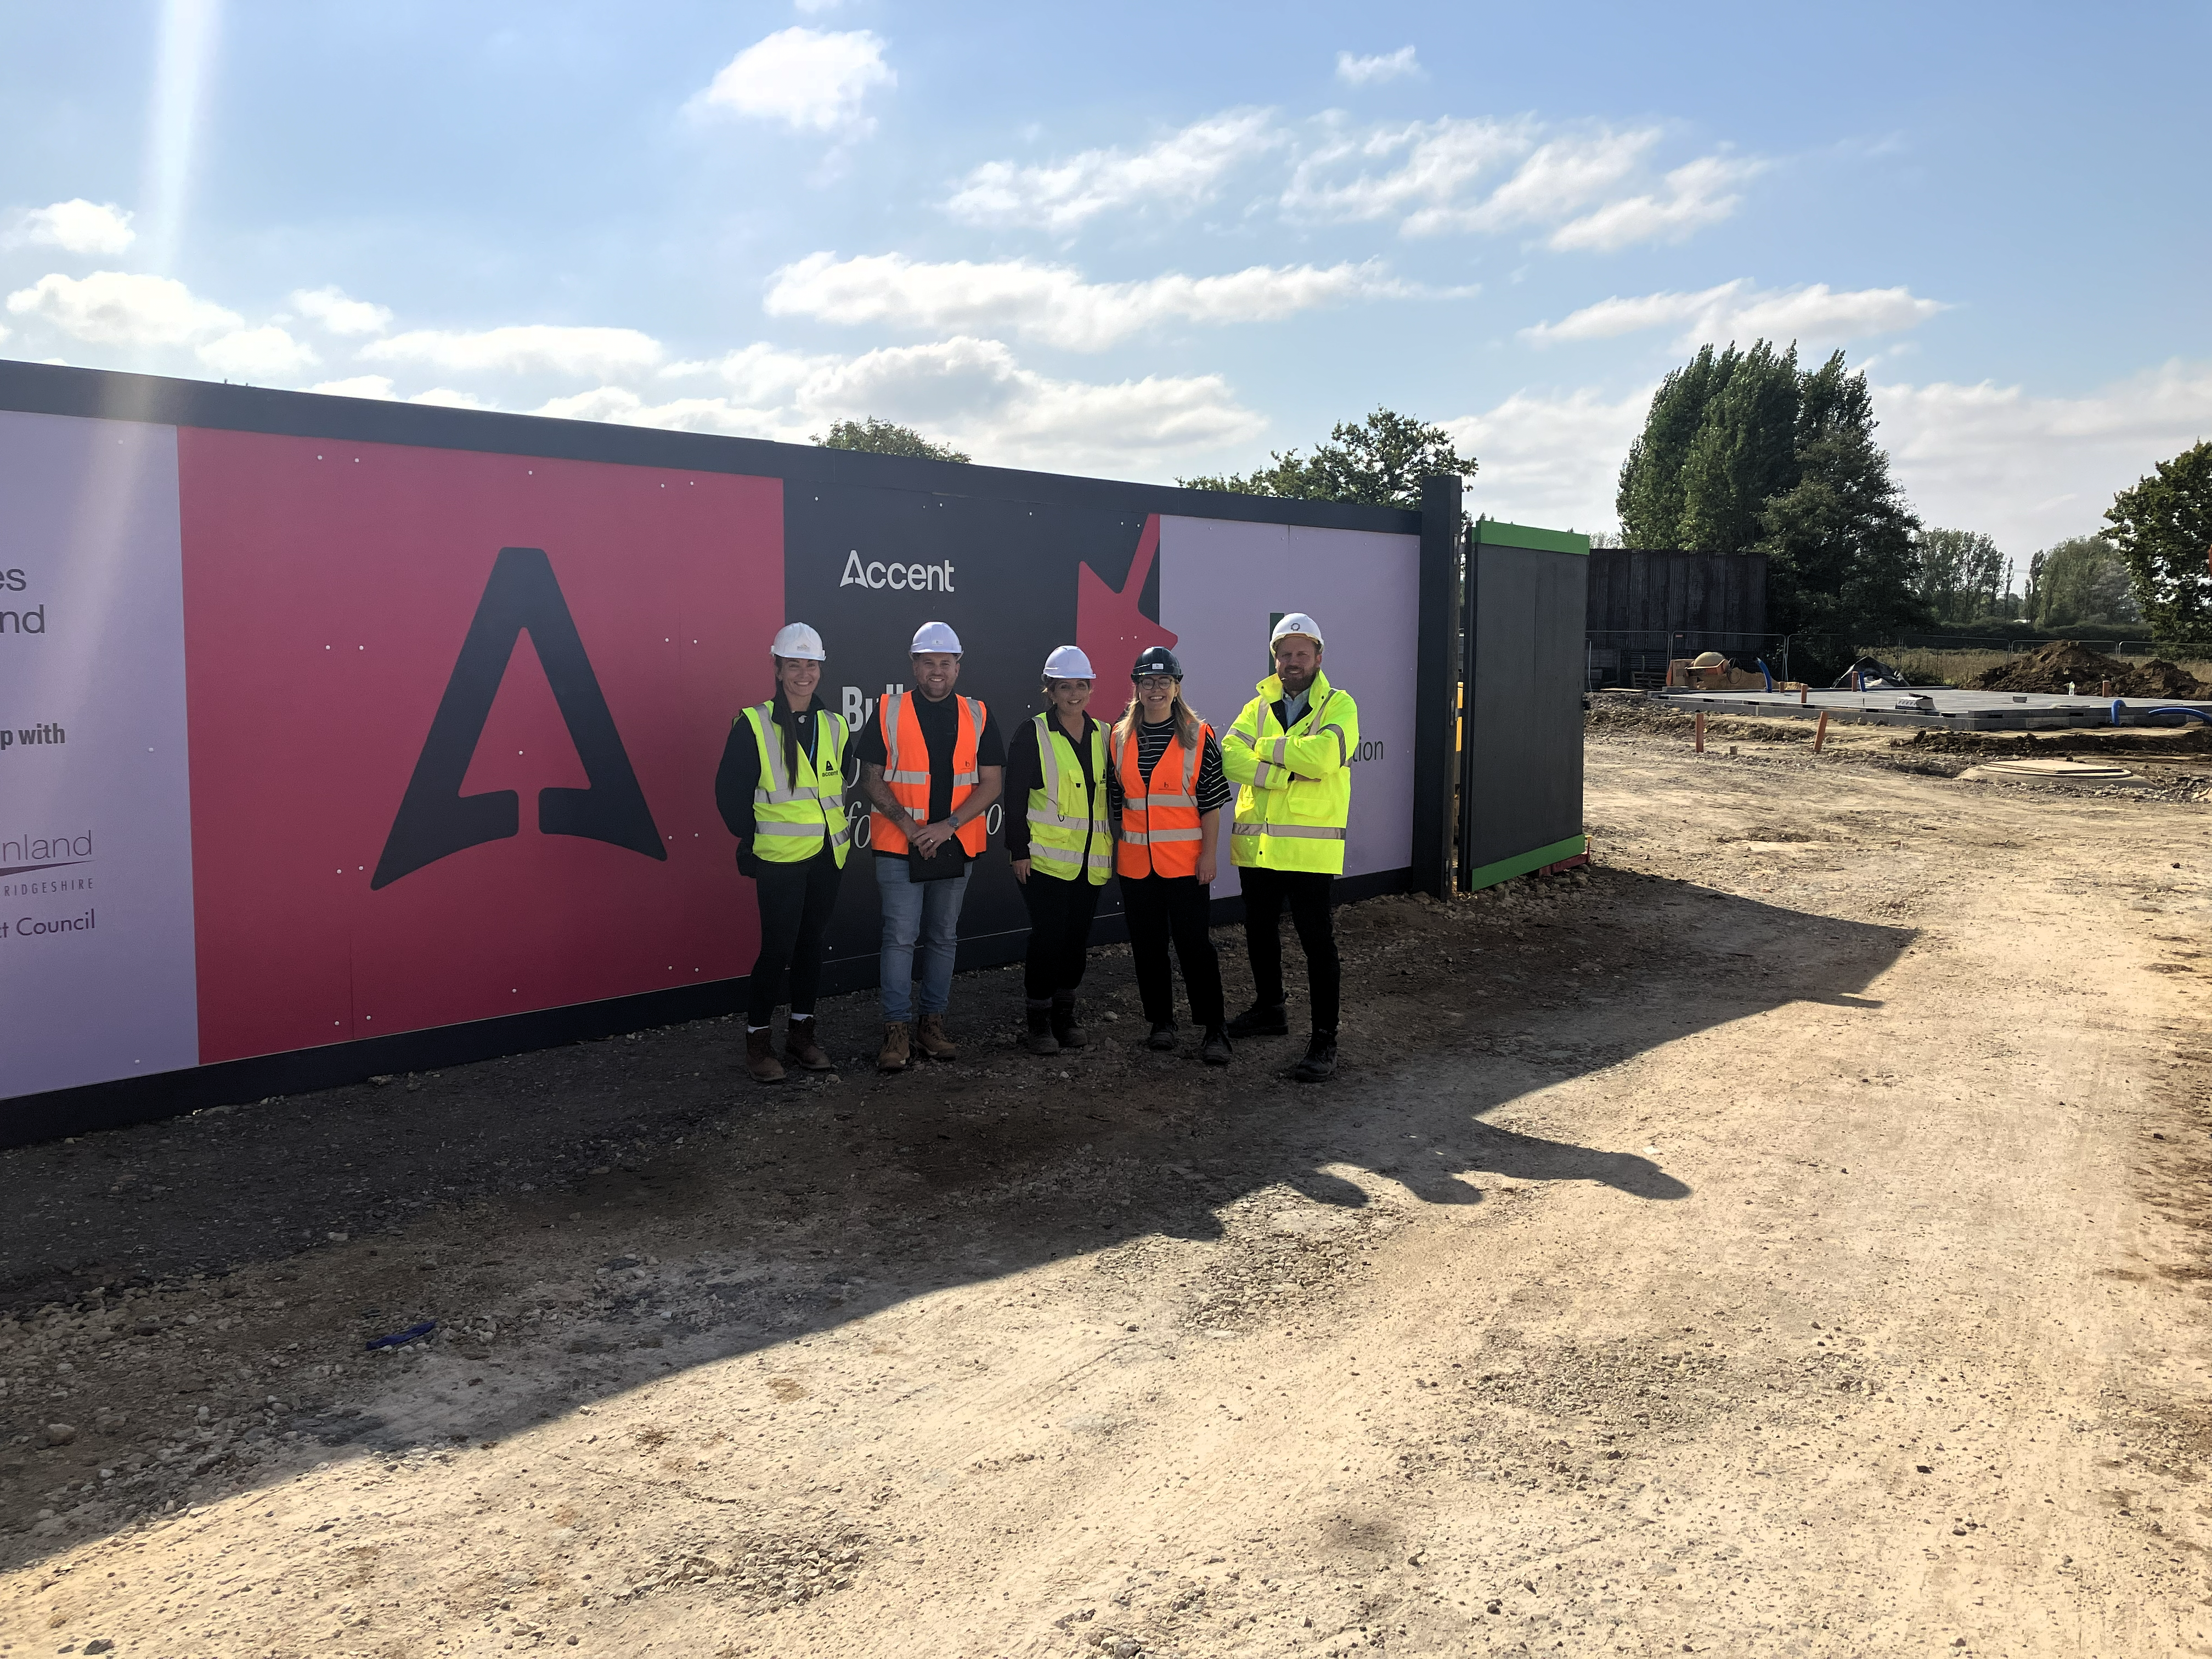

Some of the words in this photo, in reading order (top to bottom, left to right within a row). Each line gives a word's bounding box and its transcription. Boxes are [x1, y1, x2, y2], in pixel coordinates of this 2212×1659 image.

[0, 568, 27, 591] s
[839, 550, 955, 592] Accent
[0, 604, 45, 634] nd
[0, 730, 13, 750] p
[18, 723, 65, 745] with
[0, 922, 9, 939] t
[16, 908, 95, 936] Council
